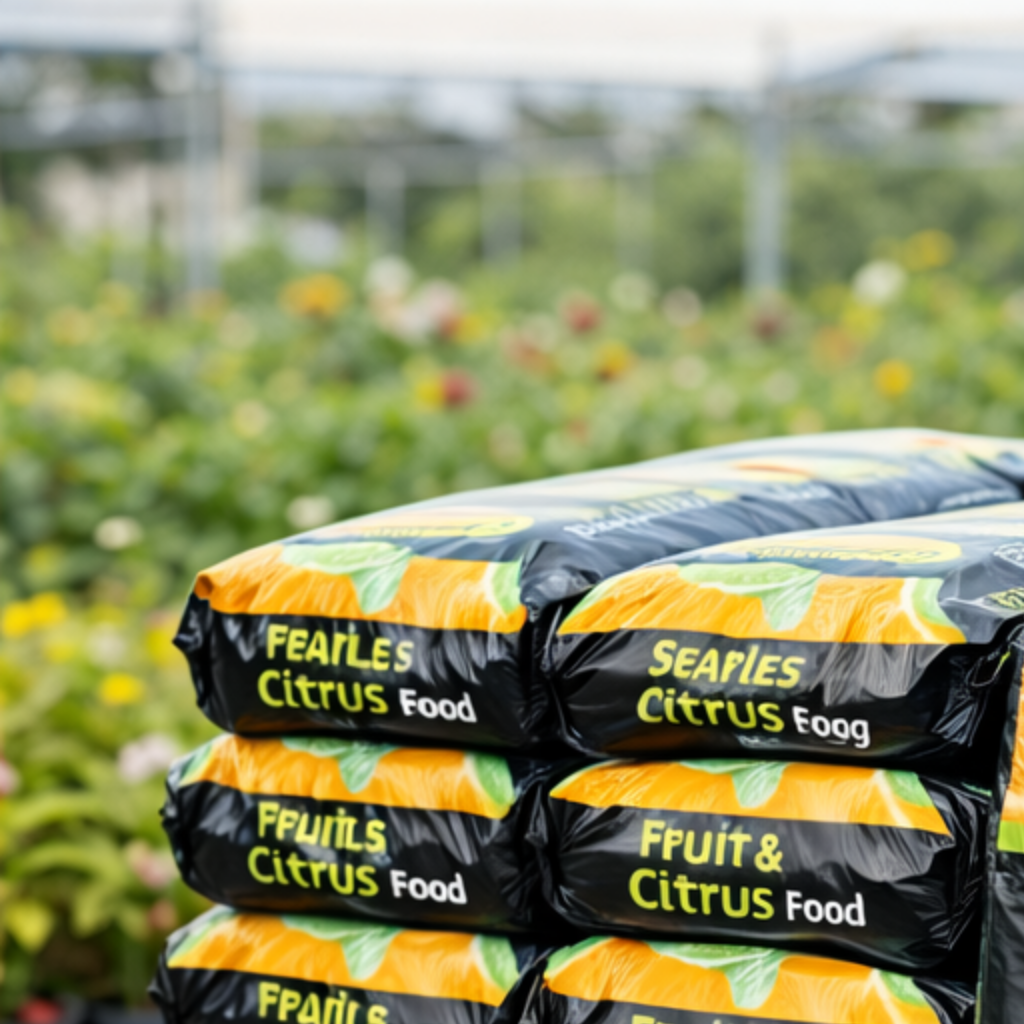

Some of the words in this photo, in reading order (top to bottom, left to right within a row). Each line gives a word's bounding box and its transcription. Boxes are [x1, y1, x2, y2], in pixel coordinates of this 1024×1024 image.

[257, 669, 389, 714] Citrus
[398, 688, 477, 723] Food
[637, 687, 785, 733] Citrus
[247, 845, 380, 898] Citrus
[389, 869, 468, 905] Food
[754, 833, 784, 874] &
[629, 868, 776, 921] Citrus
[785, 889, 867, 927] Food
